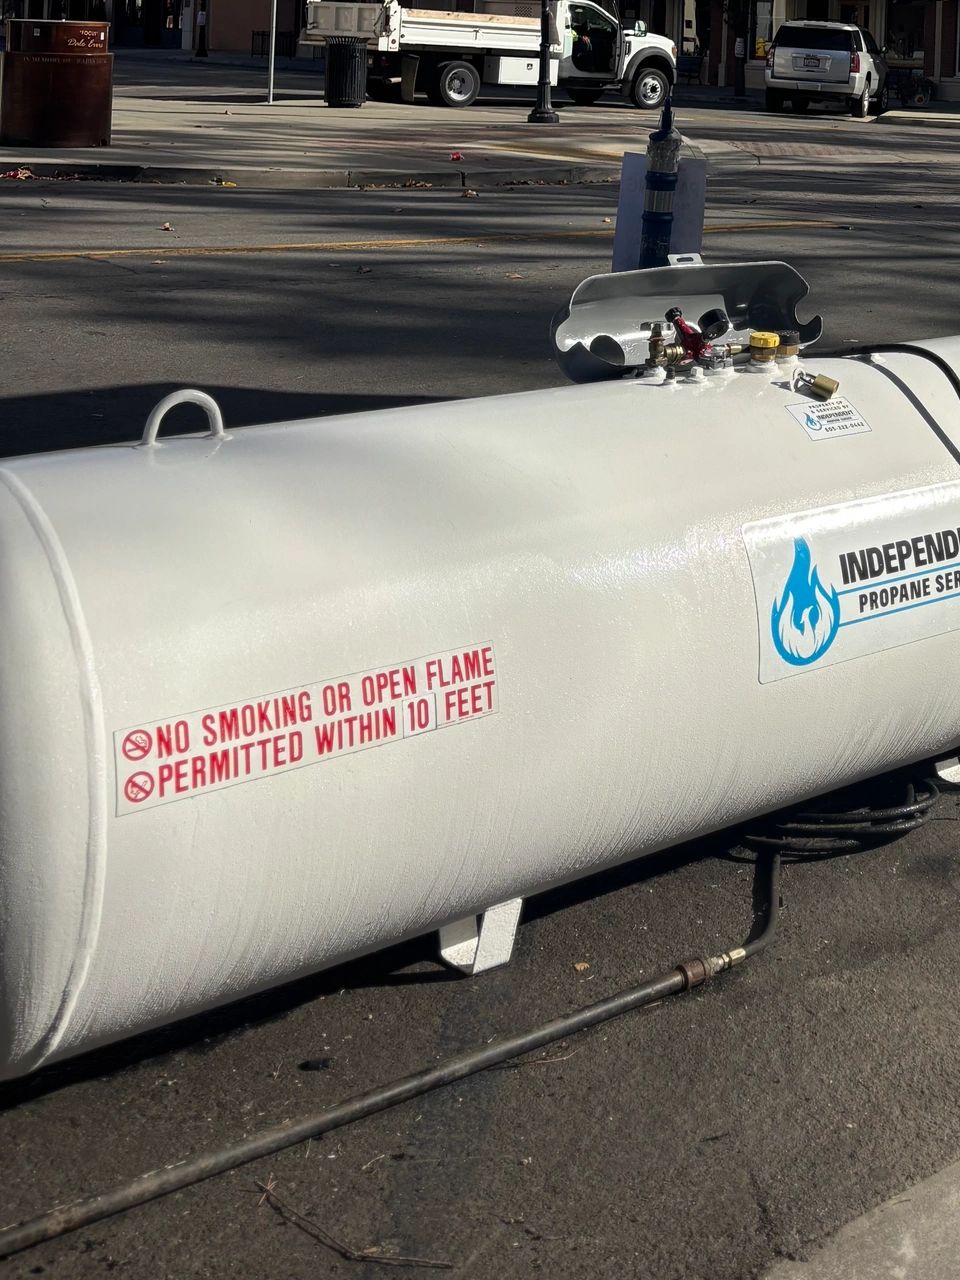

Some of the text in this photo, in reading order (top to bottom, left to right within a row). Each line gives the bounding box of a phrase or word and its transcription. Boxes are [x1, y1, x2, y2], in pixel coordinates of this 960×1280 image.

[816, 410, 854, 420] INDEPENDENT
[858, 577, 931, 613] PROPANE
[156, 646, 495, 759] NO SMOKING OR OPEN FLAME
[158, 680, 496, 798] PERMITTED WITHIN 10 FEET
